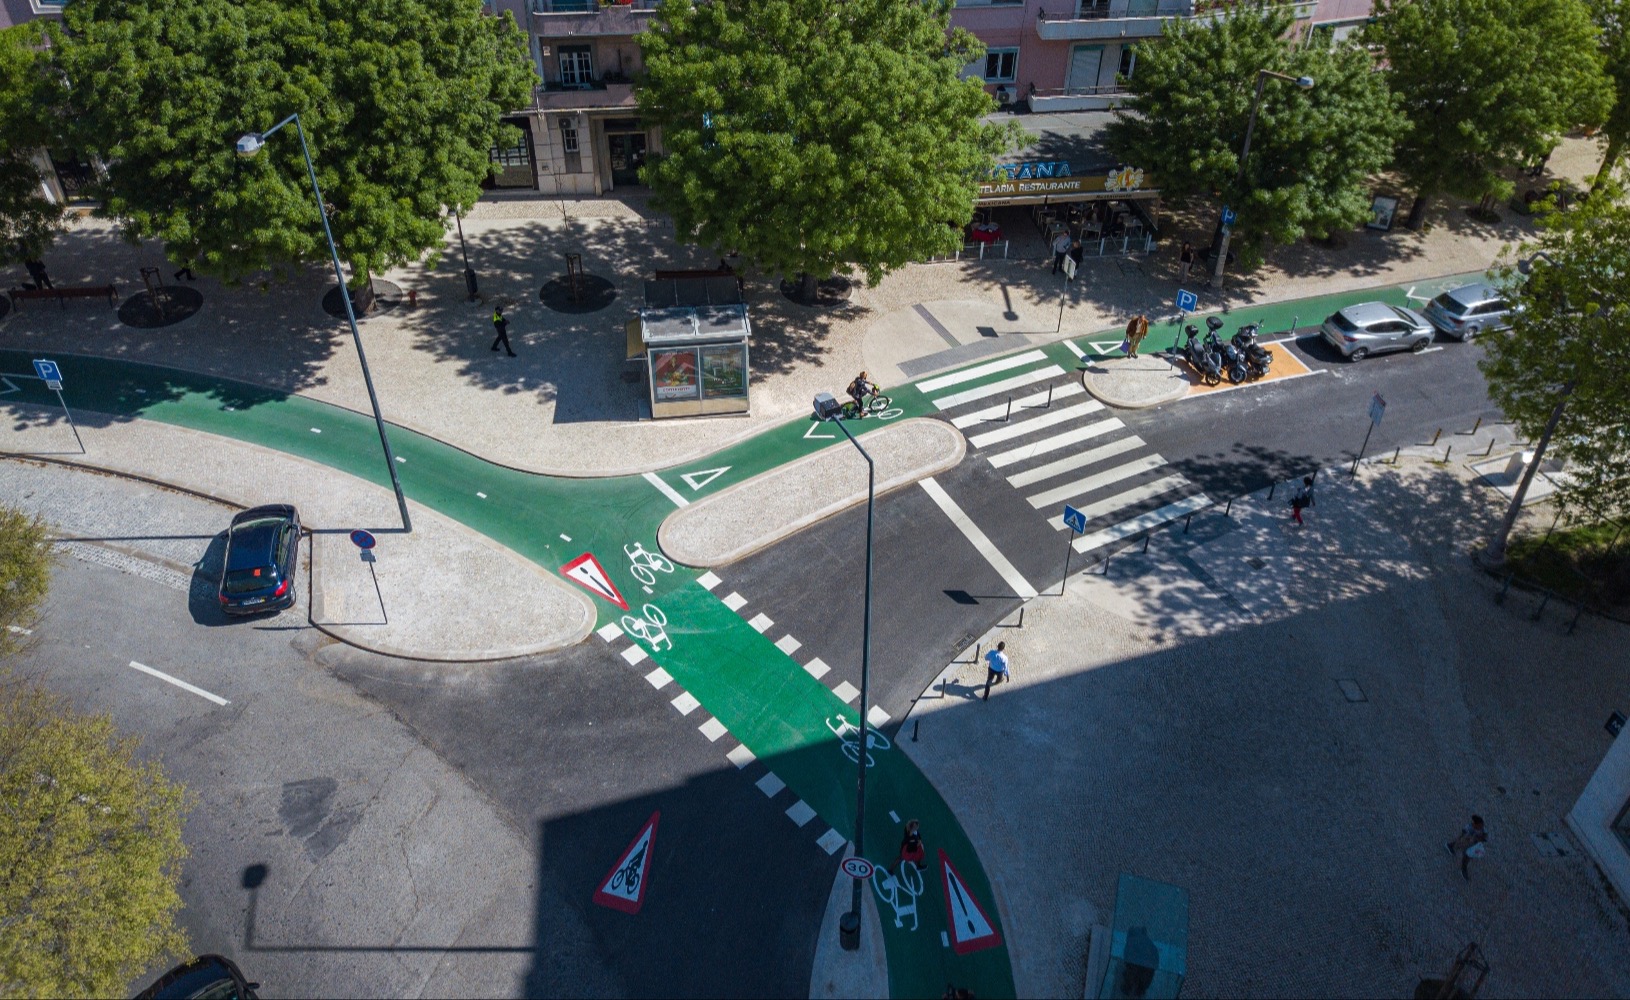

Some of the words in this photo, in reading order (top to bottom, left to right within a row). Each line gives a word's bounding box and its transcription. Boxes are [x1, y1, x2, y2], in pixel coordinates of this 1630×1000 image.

[979, 184, 1015, 194] TELARIA
[1019, 181, 1081, 192] RESTAURANTE
[1225, 210, 1234, 221] P
[1181, 292, 1192, 306] P
[39, 363, 52, 378] P
[847, 863, 868, 874] 30
